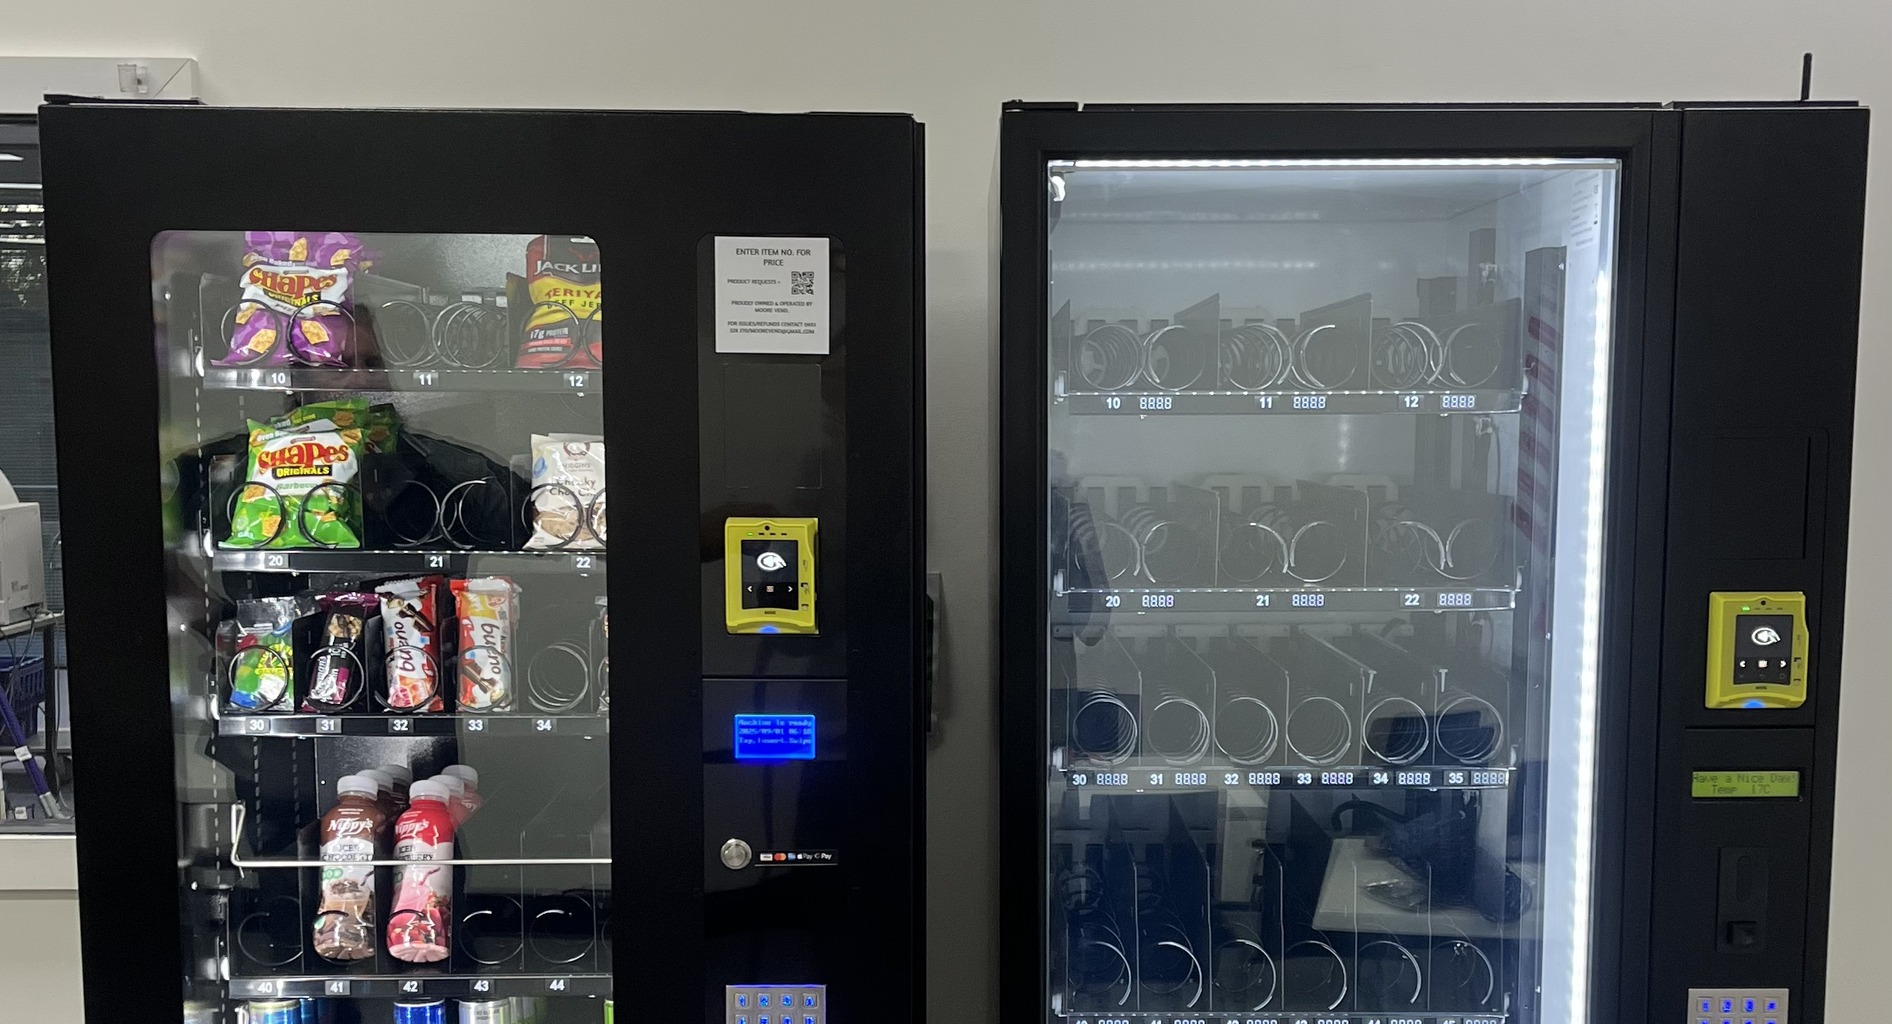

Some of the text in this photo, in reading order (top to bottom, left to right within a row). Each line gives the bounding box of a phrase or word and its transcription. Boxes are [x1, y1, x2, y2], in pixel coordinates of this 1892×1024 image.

[736, 248, 759, 256] ENTER
[761, 248, 779, 256] ITEM
[781, 248, 794, 256] NO.
[534, 260, 580, 275] JACK
[271, 372, 286, 384] 10
[420, 374, 432, 386] 11
[569, 375, 583, 387] 12
[1106, 396, 1121, 409] 10
[1260, 396, 1272, 408] 11
[1404, 395, 1419, 408] 12
[276, 466, 330, 478] ORIGINALS
[268, 555, 283, 566] 20
[430, 556, 443, 567] 21
[576, 557, 591, 568] 22
[1106, 595, 1120, 607] 20
[1256, 595, 1269, 606] 21
[1404, 594, 1420, 605] 22
[480, 623, 501, 675] bueno
[249, 719, 265, 731] 30
[321, 720, 335, 731] 31
[393, 720, 408, 731] 32
[468, 720, 483, 731] 33
[536, 719, 552, 731] 34
[1072, 773, 1087, 785] 30
[1150, 773, 1163, 785] 31
[1224, 773, 1239, 785] 32
[1297, 773, 1312, 785] 33
[1373, 773, 1388, 785] 34
[1448, 773, 1463, 785] 35
[1737, 774, 1764, 783] Nice
[327, 818, 374, 836] Nippy's
[258, 982, 273, 993] 40
[330, 982, 343, 992] 41
[403, 981, 418, 992] 42
[473, 980, 489, 991] 43
[550, 979, 565, 991] 44
